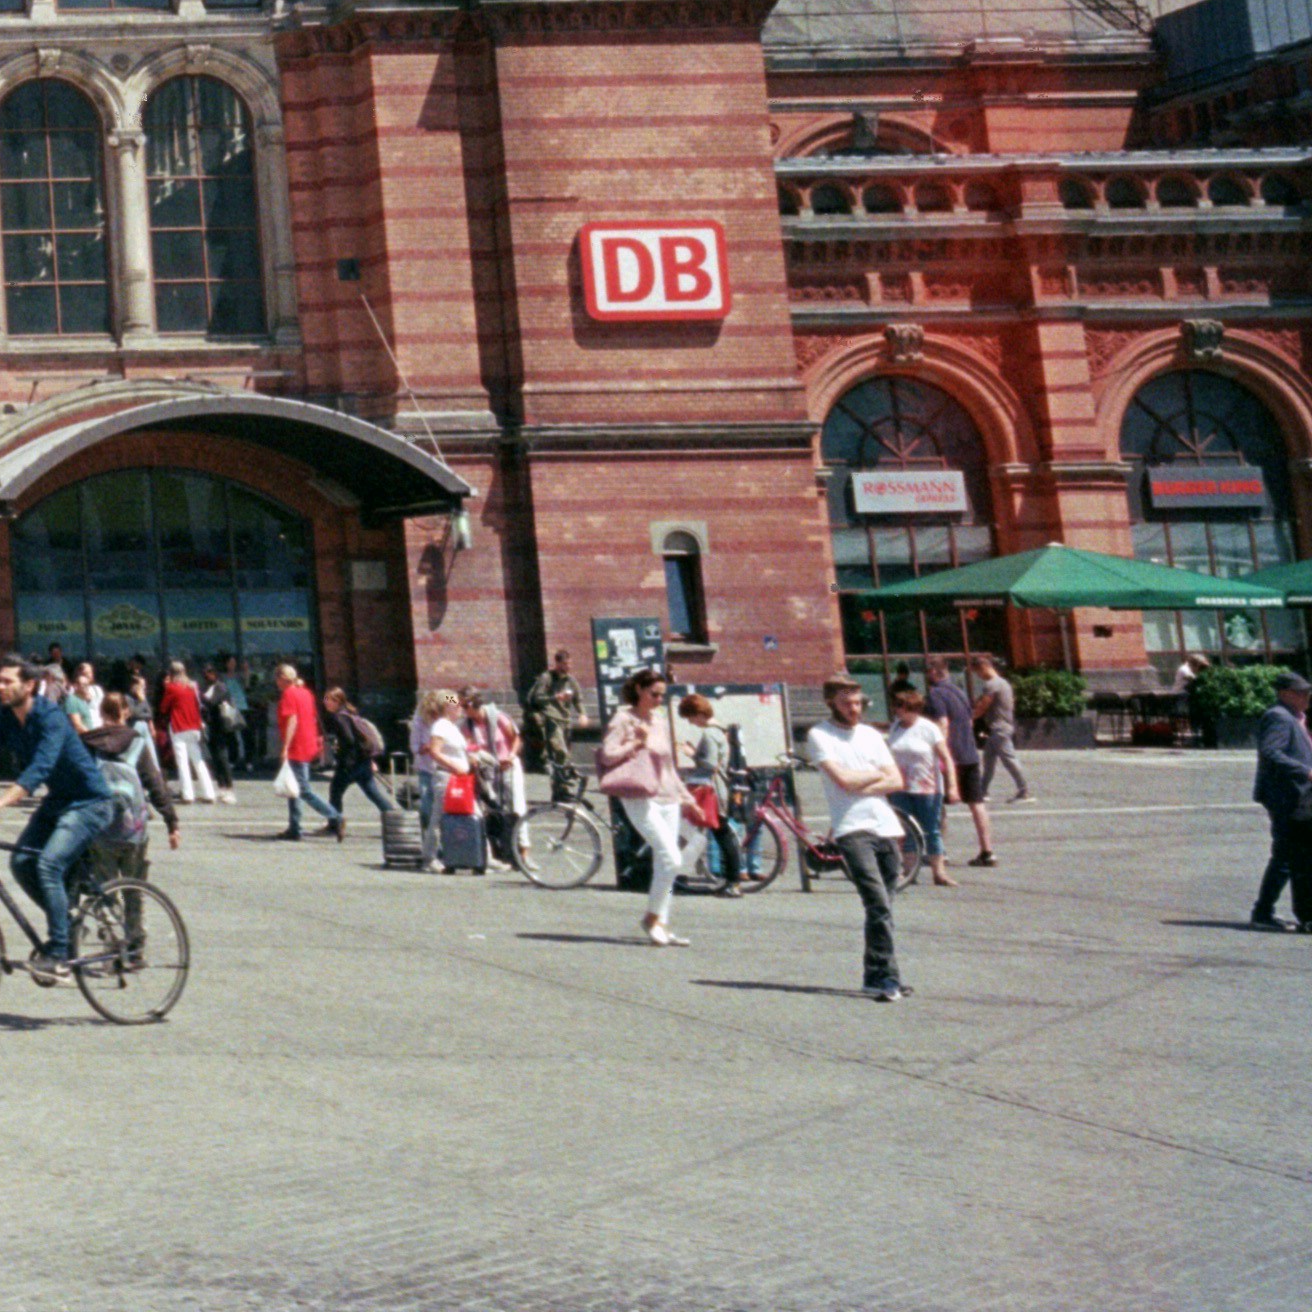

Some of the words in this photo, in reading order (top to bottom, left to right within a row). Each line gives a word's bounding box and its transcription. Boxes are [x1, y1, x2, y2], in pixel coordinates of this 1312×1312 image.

[601, 235, 713, 304] DB
[862, 480, 957, 495] ROSSMANN
[1150, 481, 1217, 495] BURGER
[1219, 479, 1263, 494] KING
